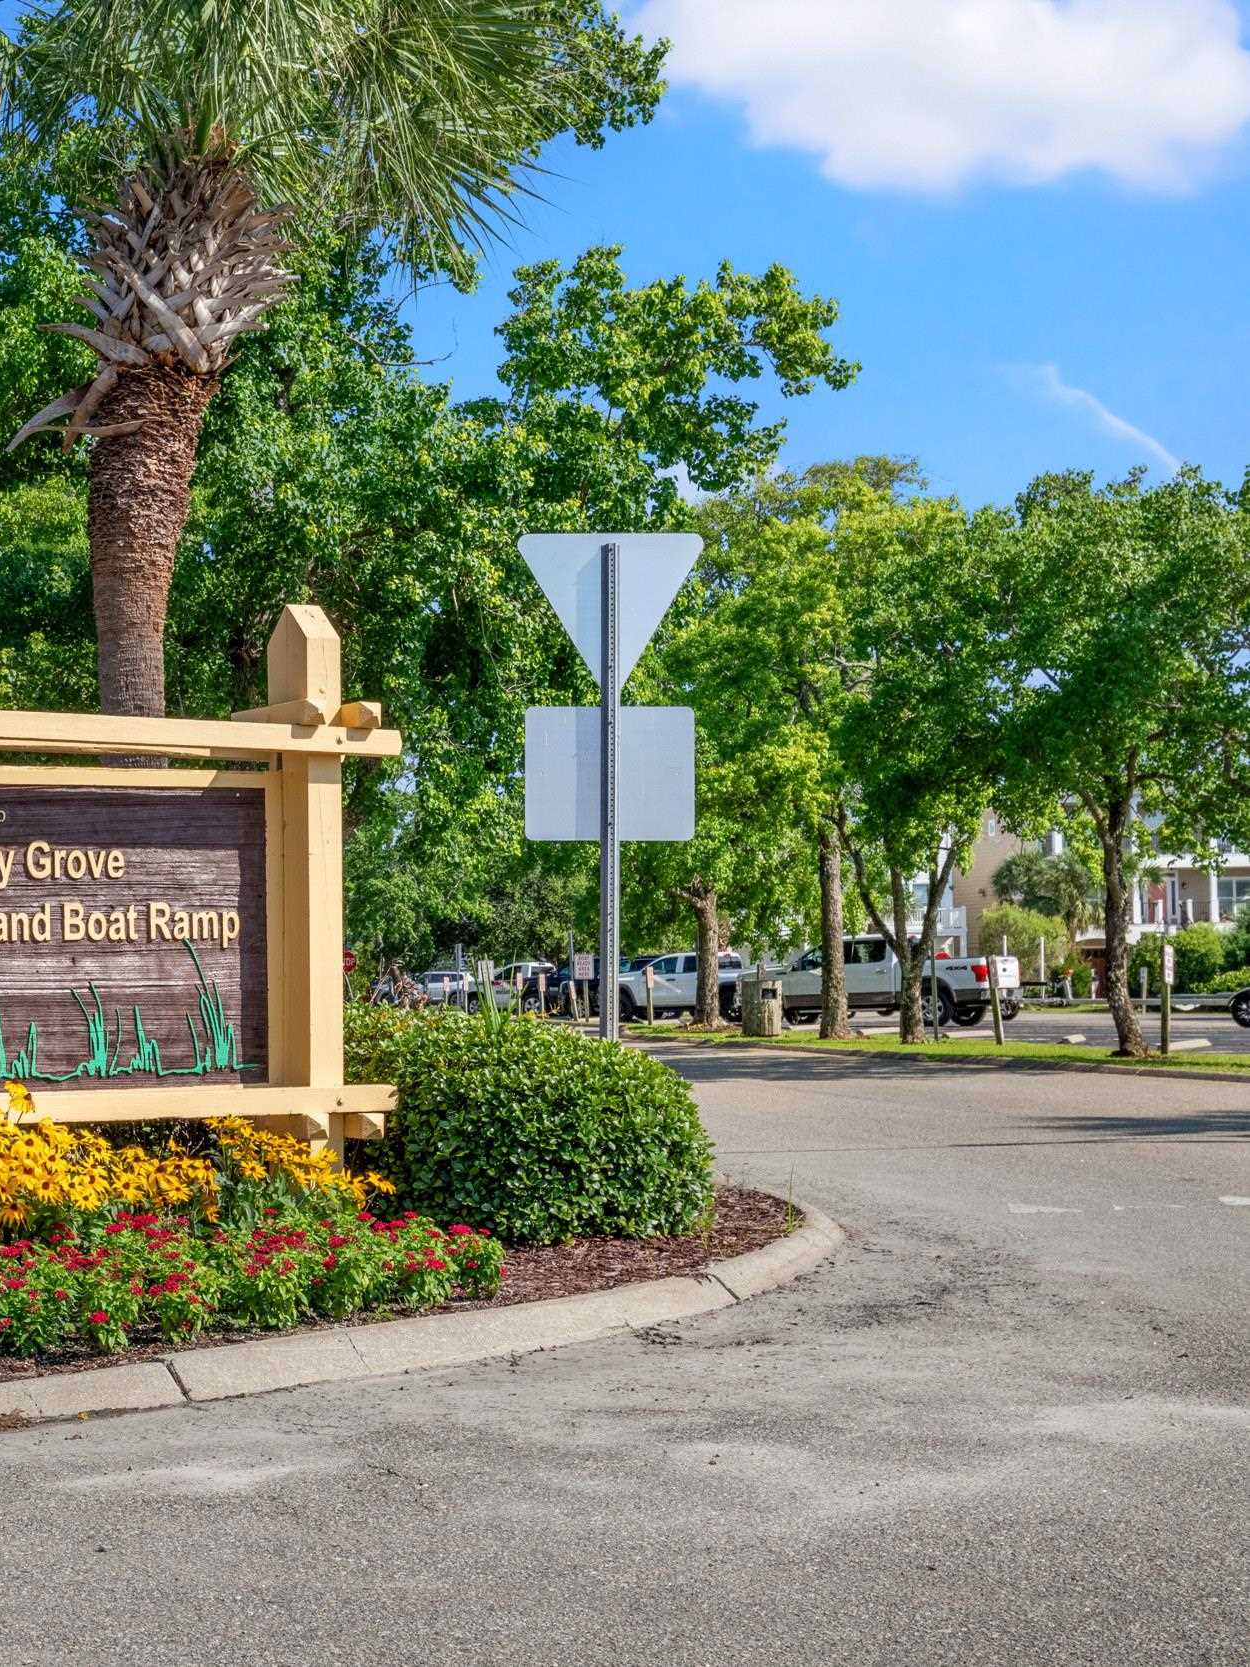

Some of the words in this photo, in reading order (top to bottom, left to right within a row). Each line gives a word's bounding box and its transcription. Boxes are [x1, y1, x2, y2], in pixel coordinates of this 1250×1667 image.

[26, 841, 126, 880] Grove
[63, 903, 139, 941] Boat
[150, 903, 240, 948] Ramp
